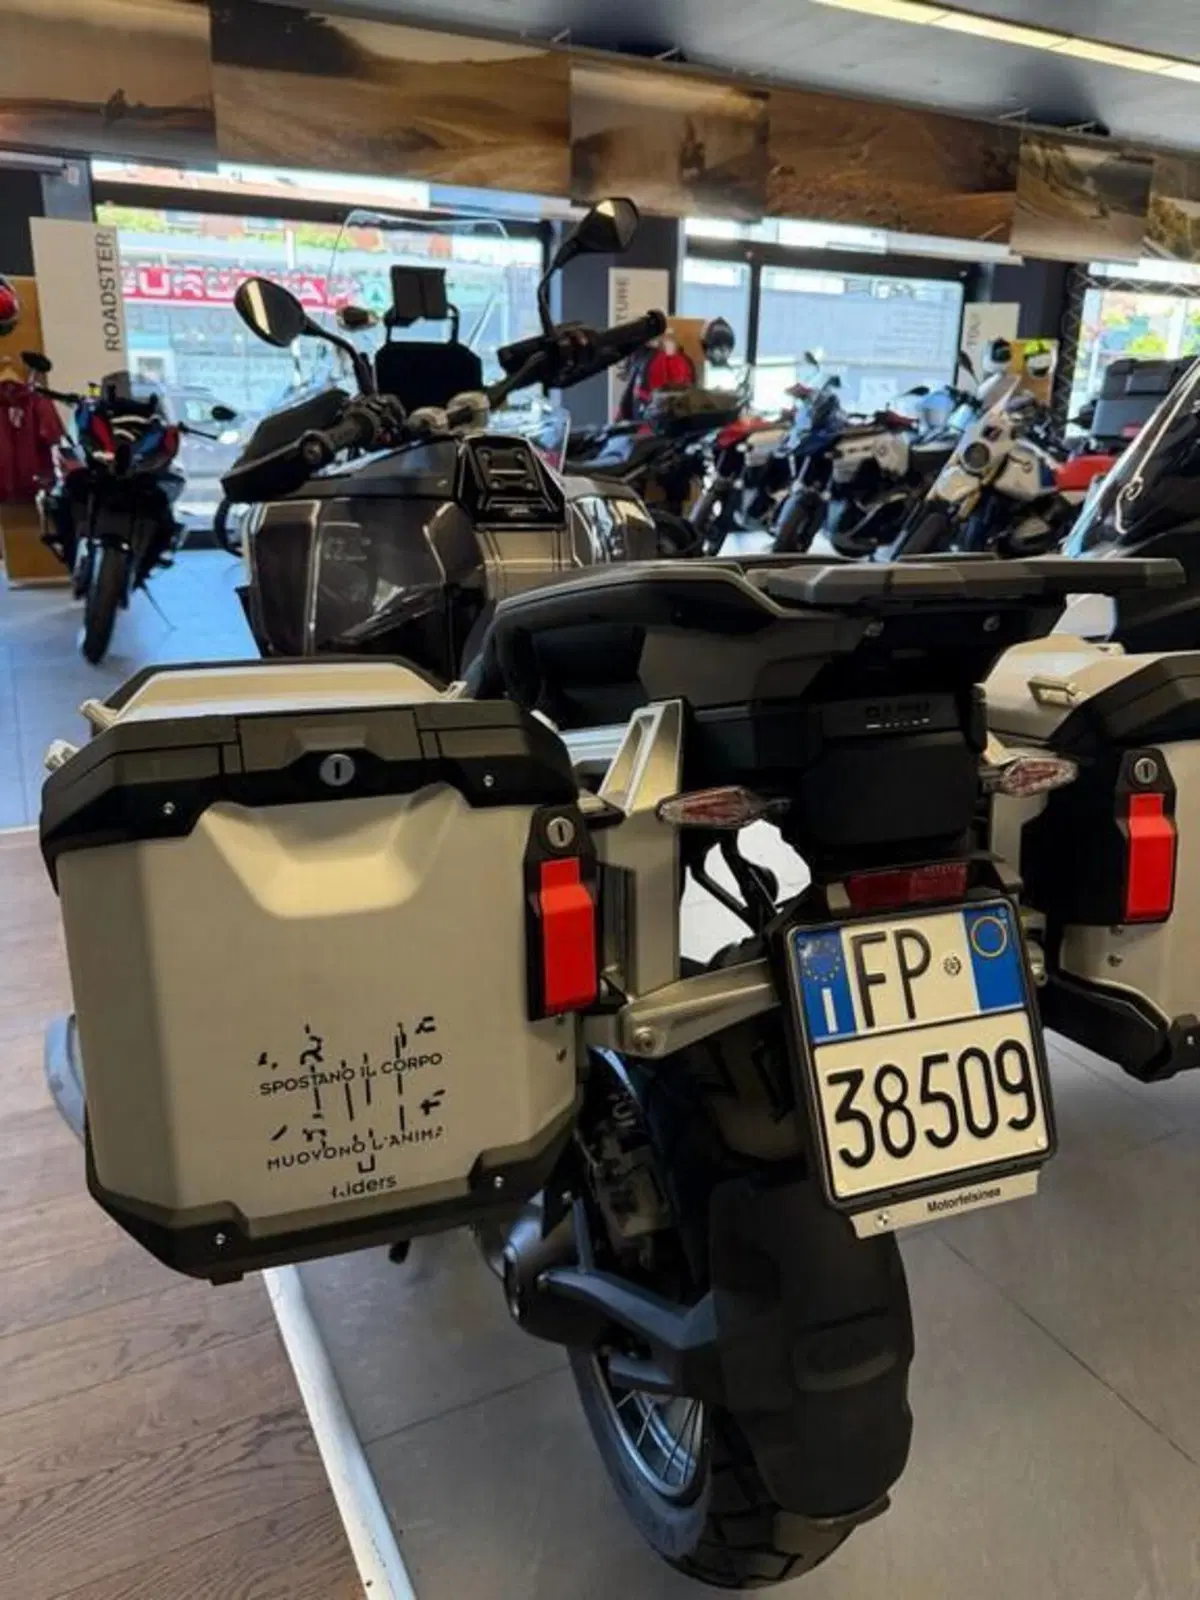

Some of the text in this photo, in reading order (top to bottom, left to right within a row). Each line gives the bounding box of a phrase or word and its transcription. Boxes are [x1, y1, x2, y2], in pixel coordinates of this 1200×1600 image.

[96, 231, 121, 351] ROADSTER
[850, 928, 932, 1028] FP
[260, 1068, 355, 1096] SPOSTANO
[381, 1052, 443, 1075] CORPO
[826, 1039, 1037, 1168] 38509
[267, 1141, 365, 1171] MUOVONO
[927, 1187, 1002, 1213] Motorfelsinea
